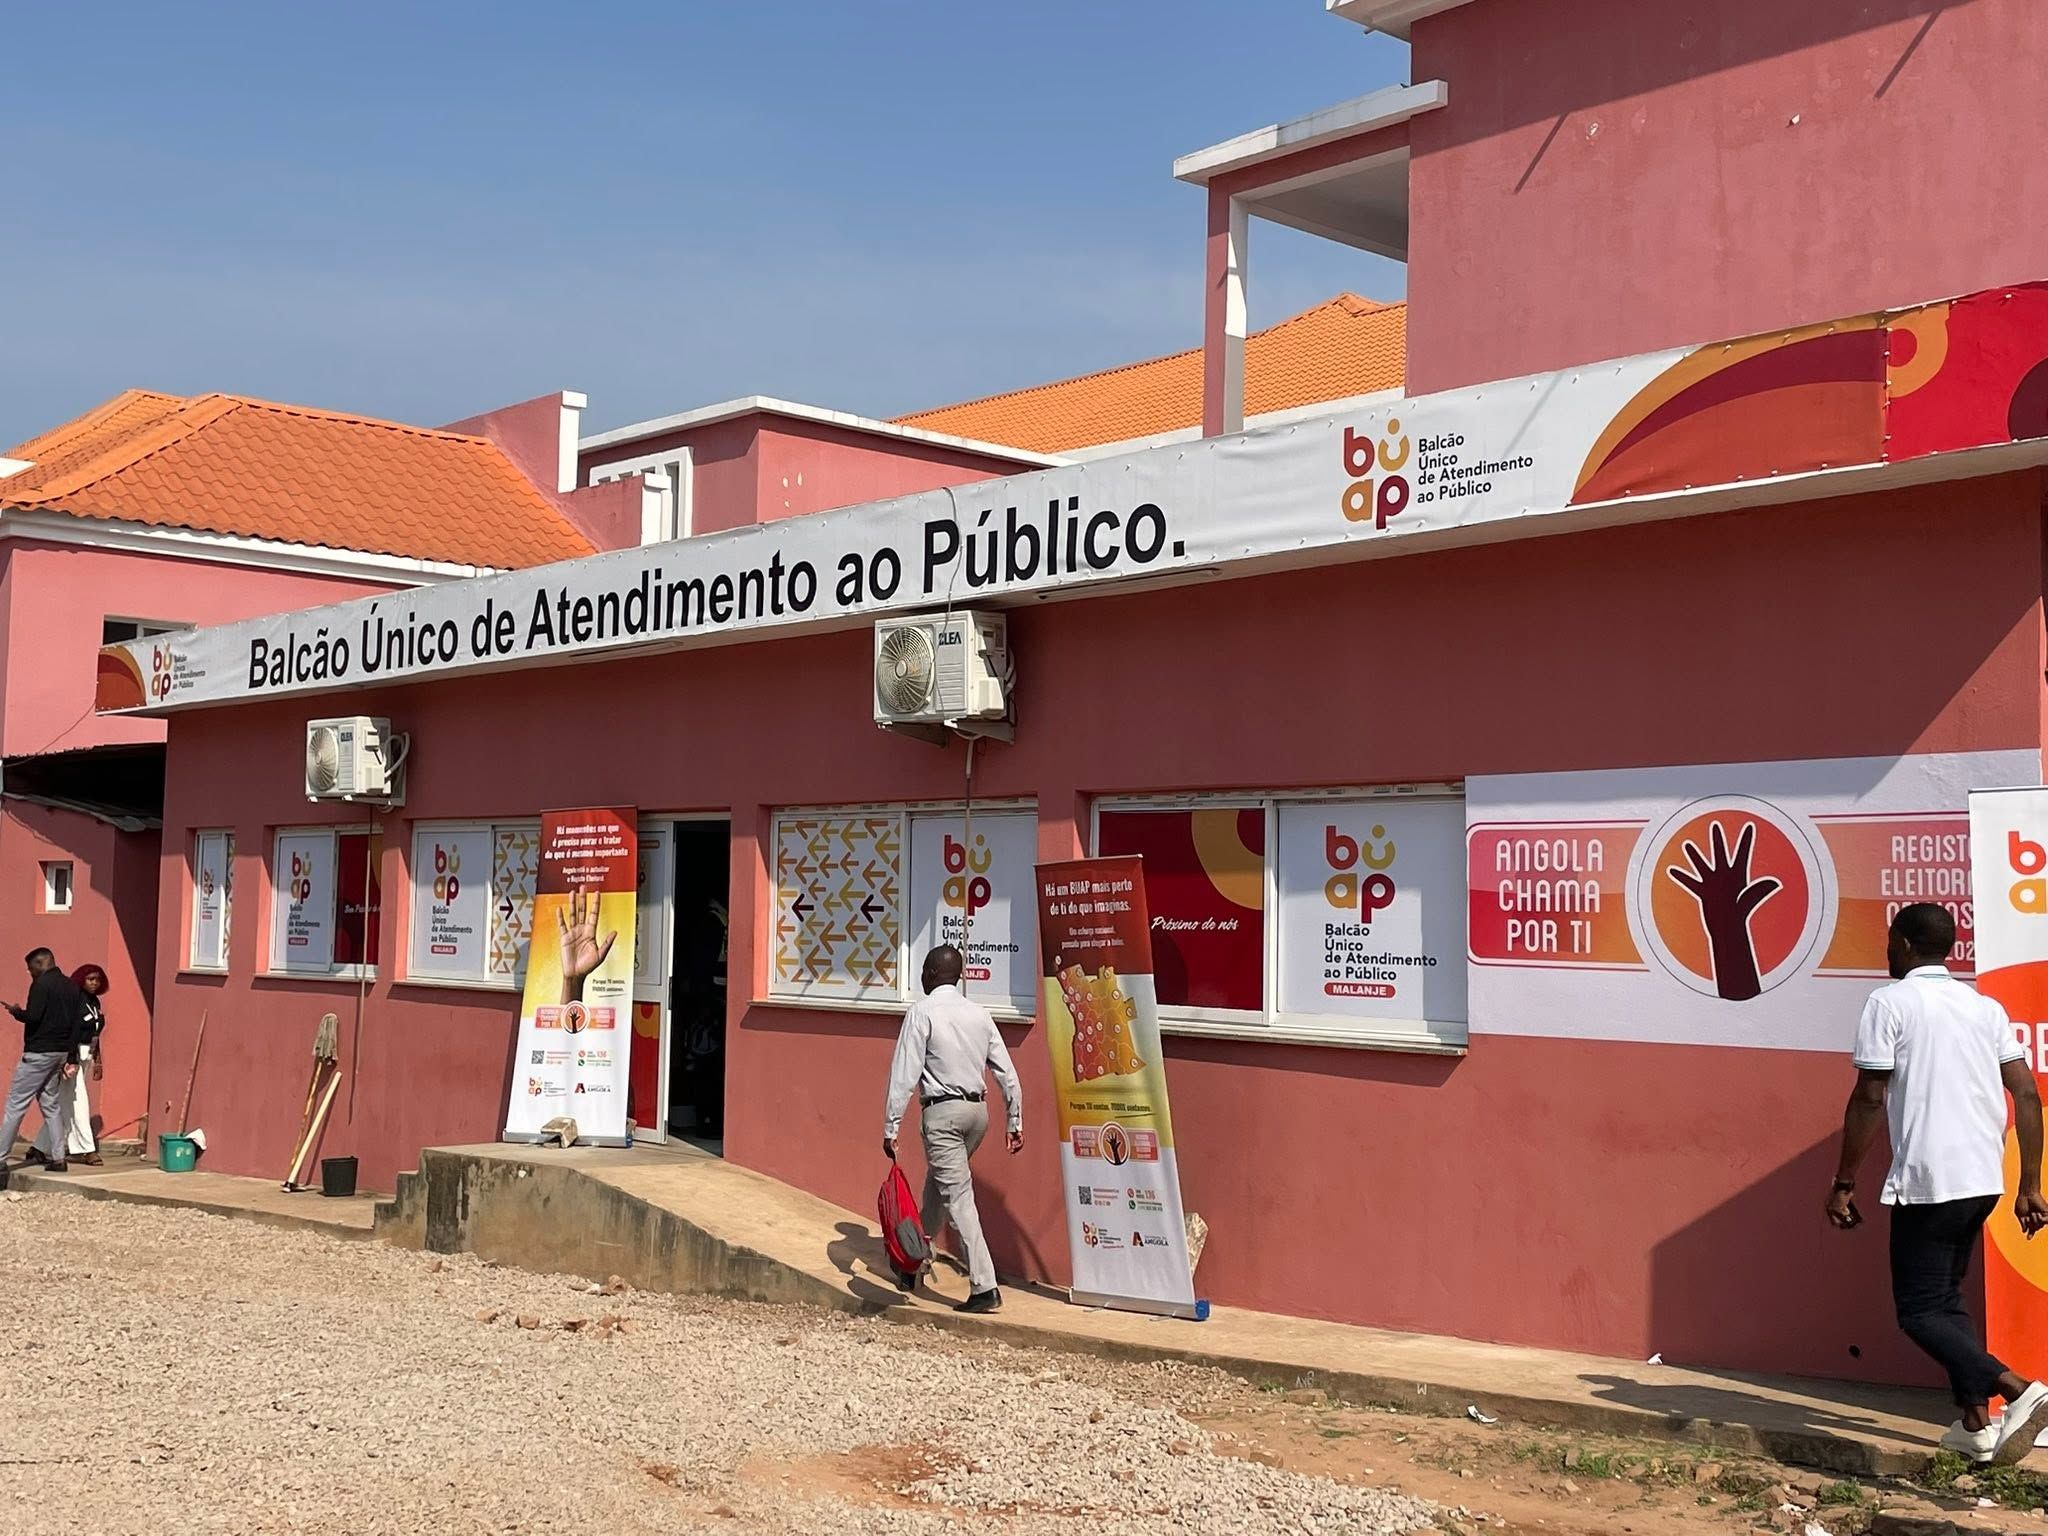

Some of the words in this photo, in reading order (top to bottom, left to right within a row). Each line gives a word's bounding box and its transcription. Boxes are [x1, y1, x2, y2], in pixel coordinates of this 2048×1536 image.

[1418, 433, 1464, 453] Balcão
[1418, 453, 1458, 470] Único
[1418, 471, 1435, 485] de
[1439, 455, 1533, 482] Atendimento
[1417, 492, 1435, 503] ao
[1439, 480, 1492, 500] Público
[249, 627, 349, 689] Balcão
[362, 603, 458, 673] Único
[471, 598, 515, 658] de
[525, 549, 818, 650] Atendimento
[835, 547, 902, 606] ao
[923, 496, 1186, 593] Público.
[1495, 838, 1604, 872] ANGOLA
[1891, 834, 1971, 862] REGIST
[1045, 882, 1055, 897] Há
[1056, 885, 1068, 896] um
[1069, 880, 1090, 895] BUAP
[1091, 880, 1110, 893] mais
[1111, 878, 1133, 895] perto
[1498, 879, 1601, 913] CHAMA
[1050, 902, 1059, 916] de
[1060, 902, 1067, 915] ti
[1068, 901, 1078, 914] do
[1079, 903, 1093, 916] que
[1094, 900, 1132, 915] imaginas.
[1151, 916, 1201, 931] Próximo
[1201, 916, 1217, 931] de
[1217, 917, 1239, 931] nós
[1325, 923, 1370, 936] Balcão
[1325, 936, 1364, 951] Único
[1507, 919, 1558, 953] POR
[1570, 920, 1591, 954] TI
[957, 940, 1019, 953] Aendimento
[1324, 951, 1342, 963] de
[1346, 952, 1438, 967] Atendimento
[1324, 968, 1341, 979] ao
[1346, 966, 1397, 981] Público
[1332, 984, 1388, 996] MALANJE
